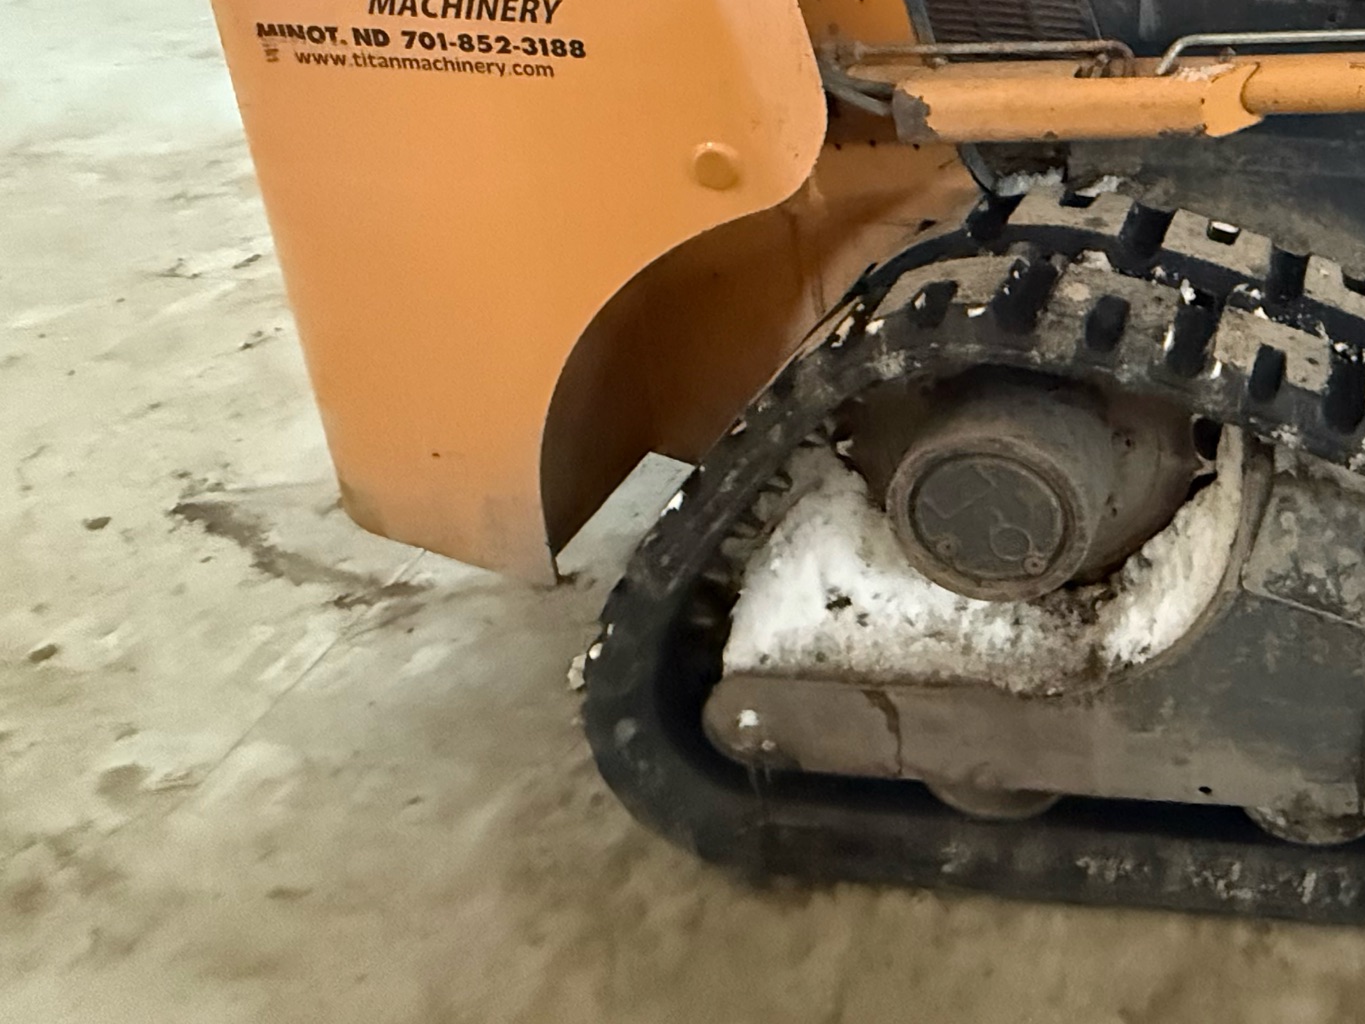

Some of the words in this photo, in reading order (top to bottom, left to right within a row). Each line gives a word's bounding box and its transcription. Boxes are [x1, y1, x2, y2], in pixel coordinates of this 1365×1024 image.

[352, 27, 390, 48] ND
[401, 30, 586, 59] 701-852-3188
[295, 50, 554, 78] www.titanmachinery.com
